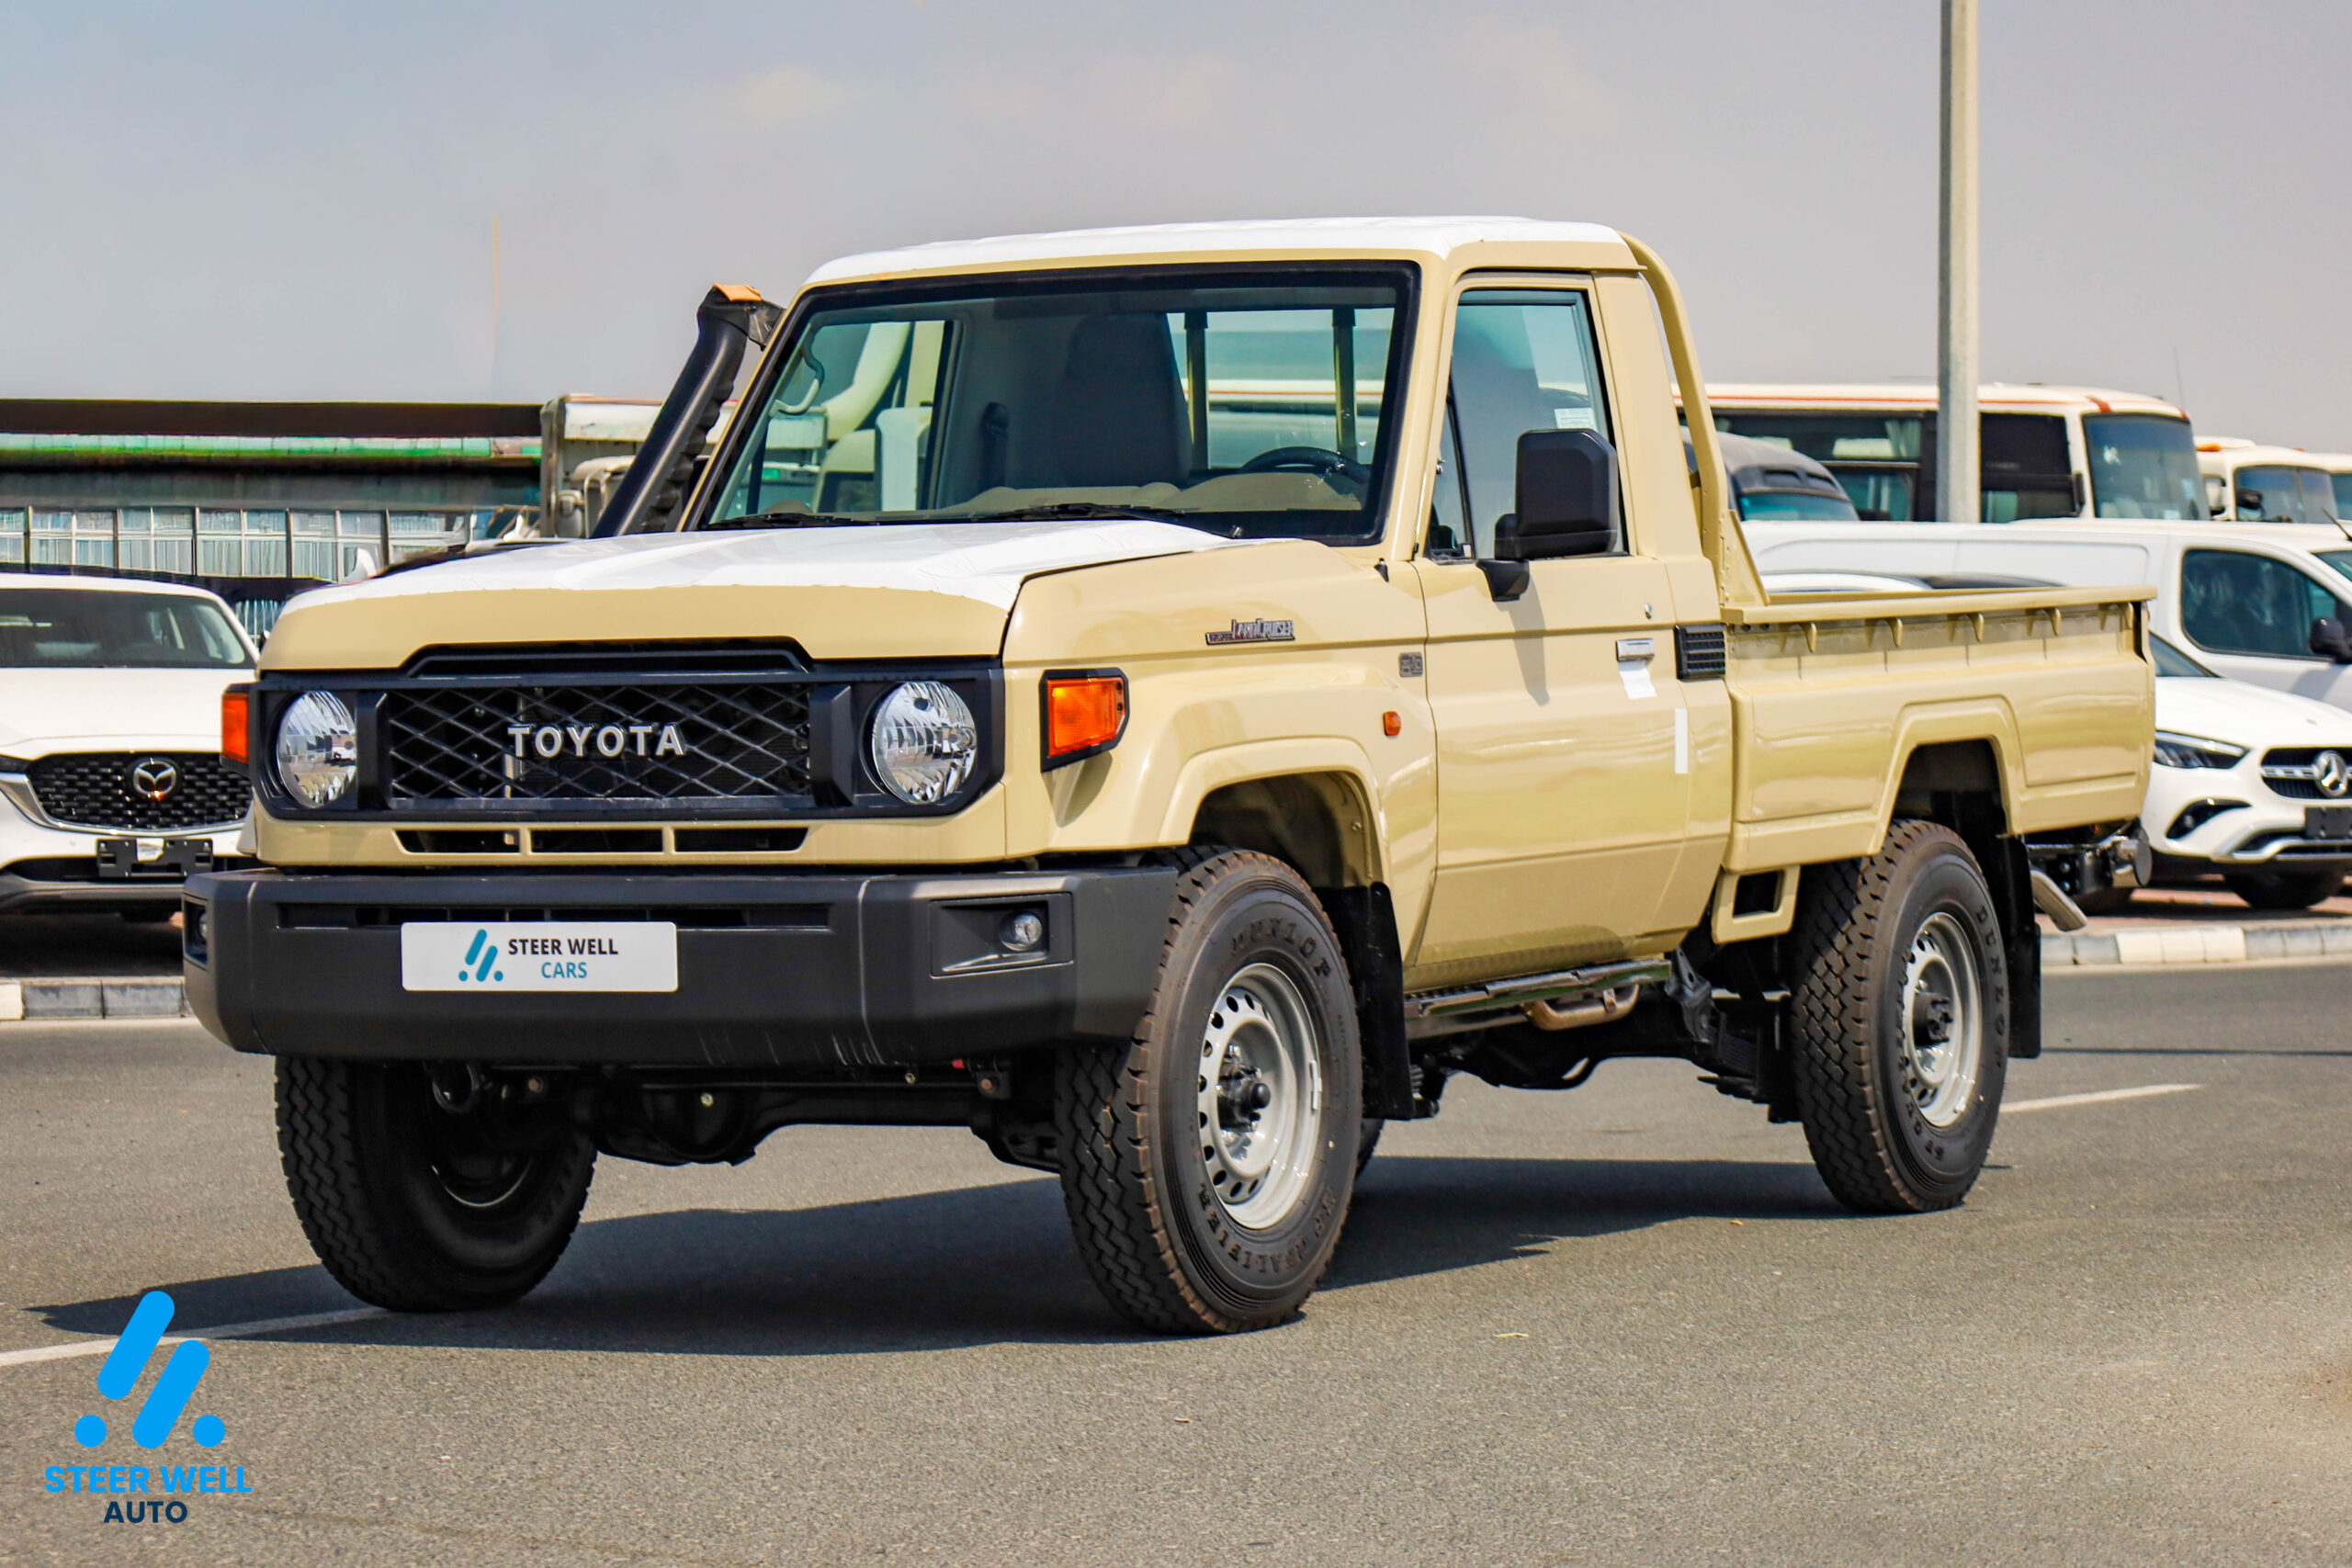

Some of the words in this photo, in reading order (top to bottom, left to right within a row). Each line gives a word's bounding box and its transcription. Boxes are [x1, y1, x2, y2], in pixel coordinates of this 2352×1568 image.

[507, 724, 684, 758] TOYOTA
[508, 938, 562, 955] STEER
[568, 938, 618, 955] WELL
[541, 961, 587, 978] CARS
